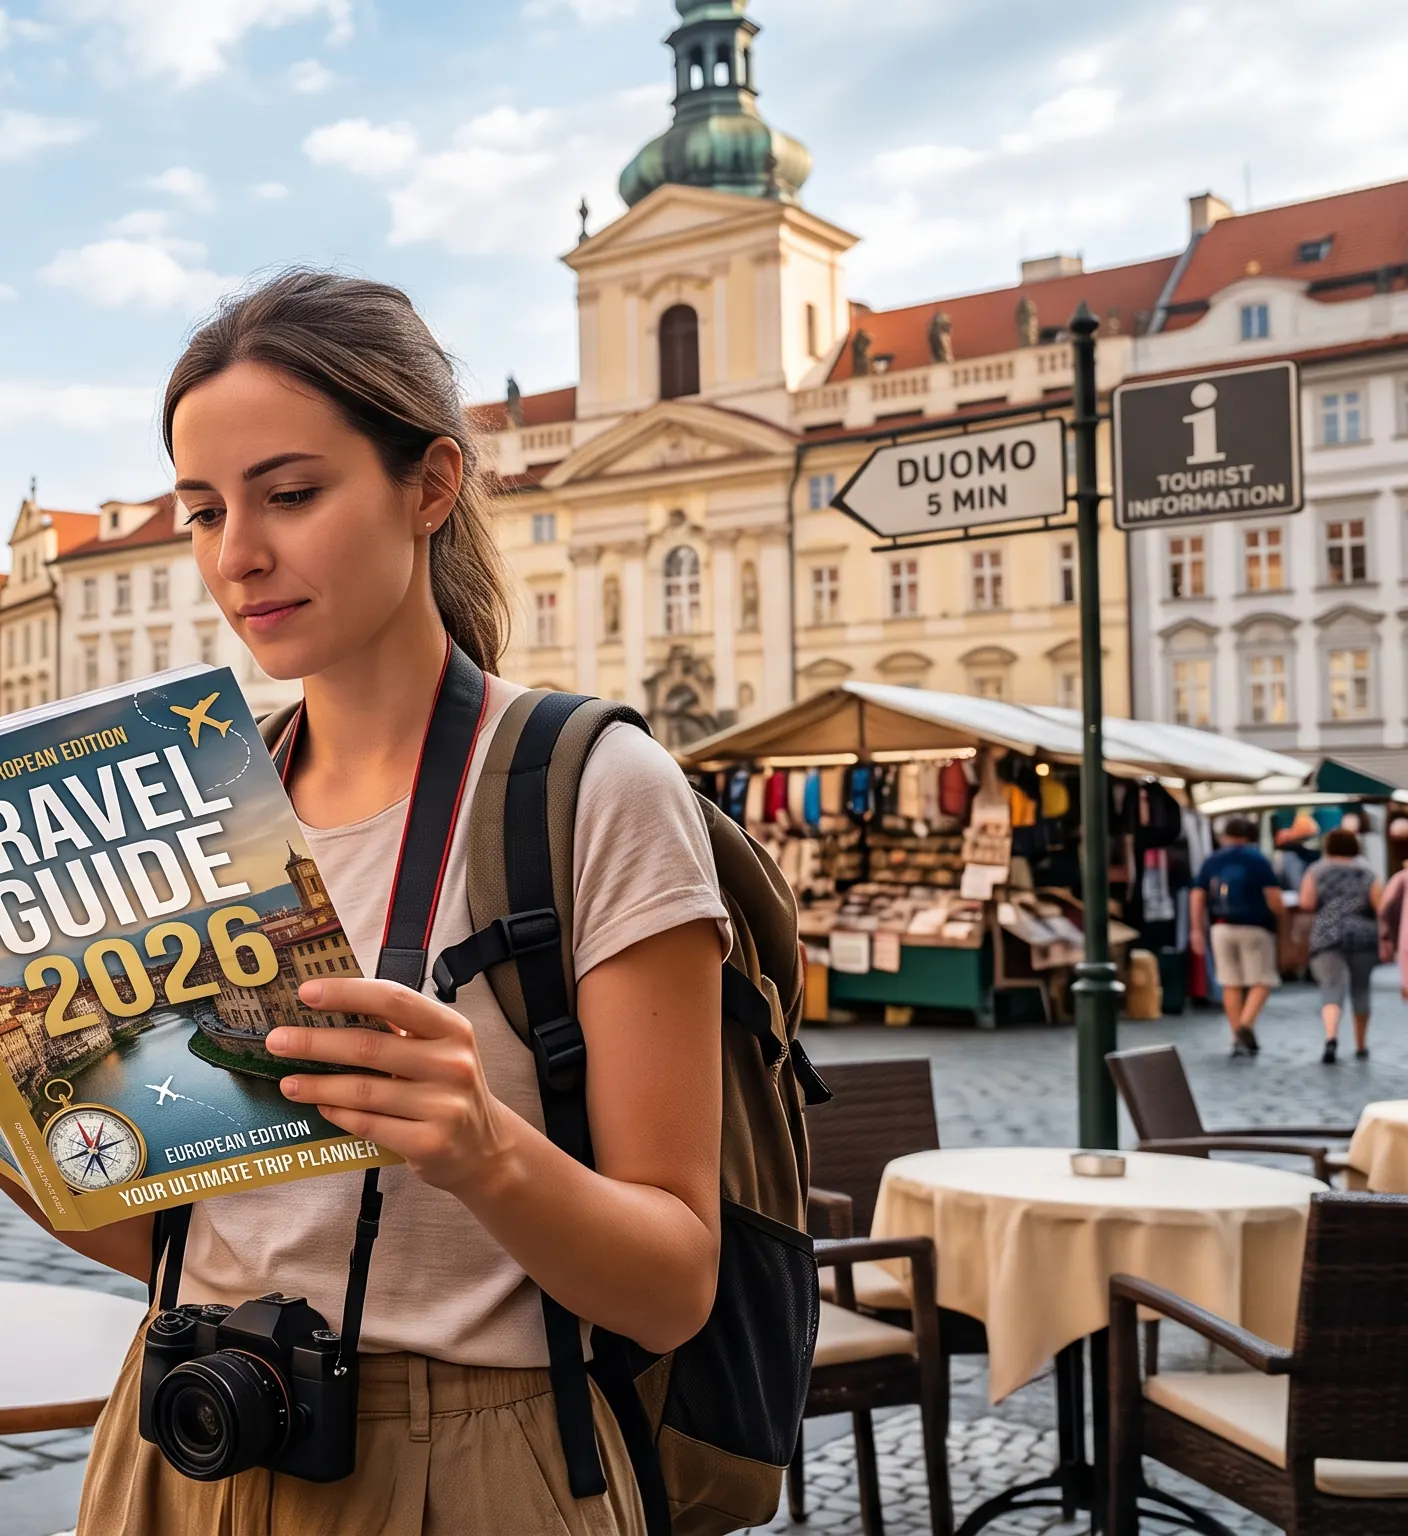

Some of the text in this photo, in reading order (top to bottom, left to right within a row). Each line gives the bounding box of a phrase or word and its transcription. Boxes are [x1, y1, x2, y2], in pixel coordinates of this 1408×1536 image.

[897, 440, 1036, 488] DUOMO
[1156, 464, 1255, 493] TOURIST
[927, 483, 1007, 516] 5 MIN
[1127, 483, 1286, 519] INFORMATION
[59, 726, 129, 761] EDITION
[23, 905, 280, 1039] 2026
[164, 1119, 311, 1164] EUROPEAN EDITION
[118, 1140, 380, 1207] YOUR ULTIMATE TRIP PLANNER
